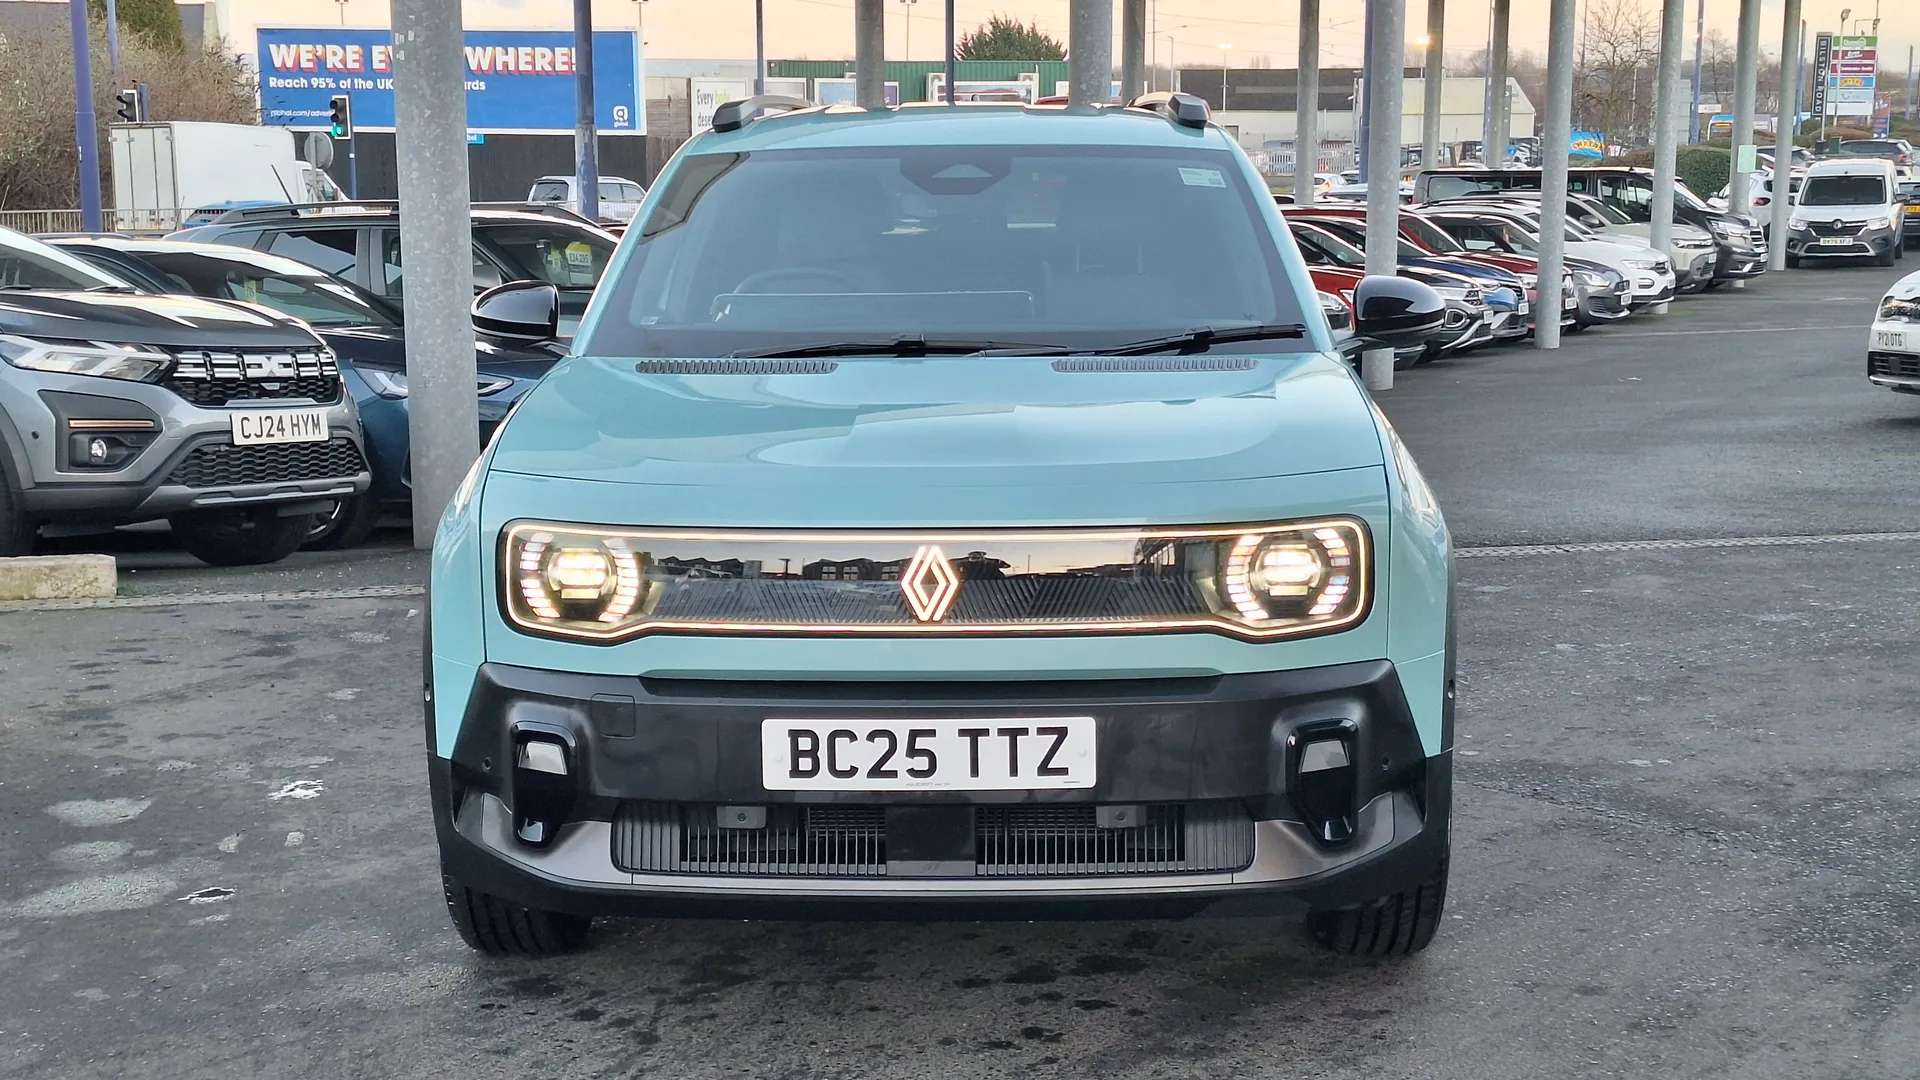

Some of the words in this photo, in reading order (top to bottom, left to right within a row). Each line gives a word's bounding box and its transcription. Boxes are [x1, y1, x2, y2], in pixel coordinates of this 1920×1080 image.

[269, 44, 364, 72] WE'RE
[268, 77, 308, 89] Reach
[310, 77, 336, 89] 95%
[340, 78, 352, 89] of
[354, 78, 374, 89] the
[377, 79, 395, 90] UK
[1815, 86, 1823, 112] ROAD
[240, 415, 286, 439] CJ24
[290, 413, 322, 437] HYM
[787, 728, 937, 779] BC25
[957, 726, 1070, 777] TTZ
